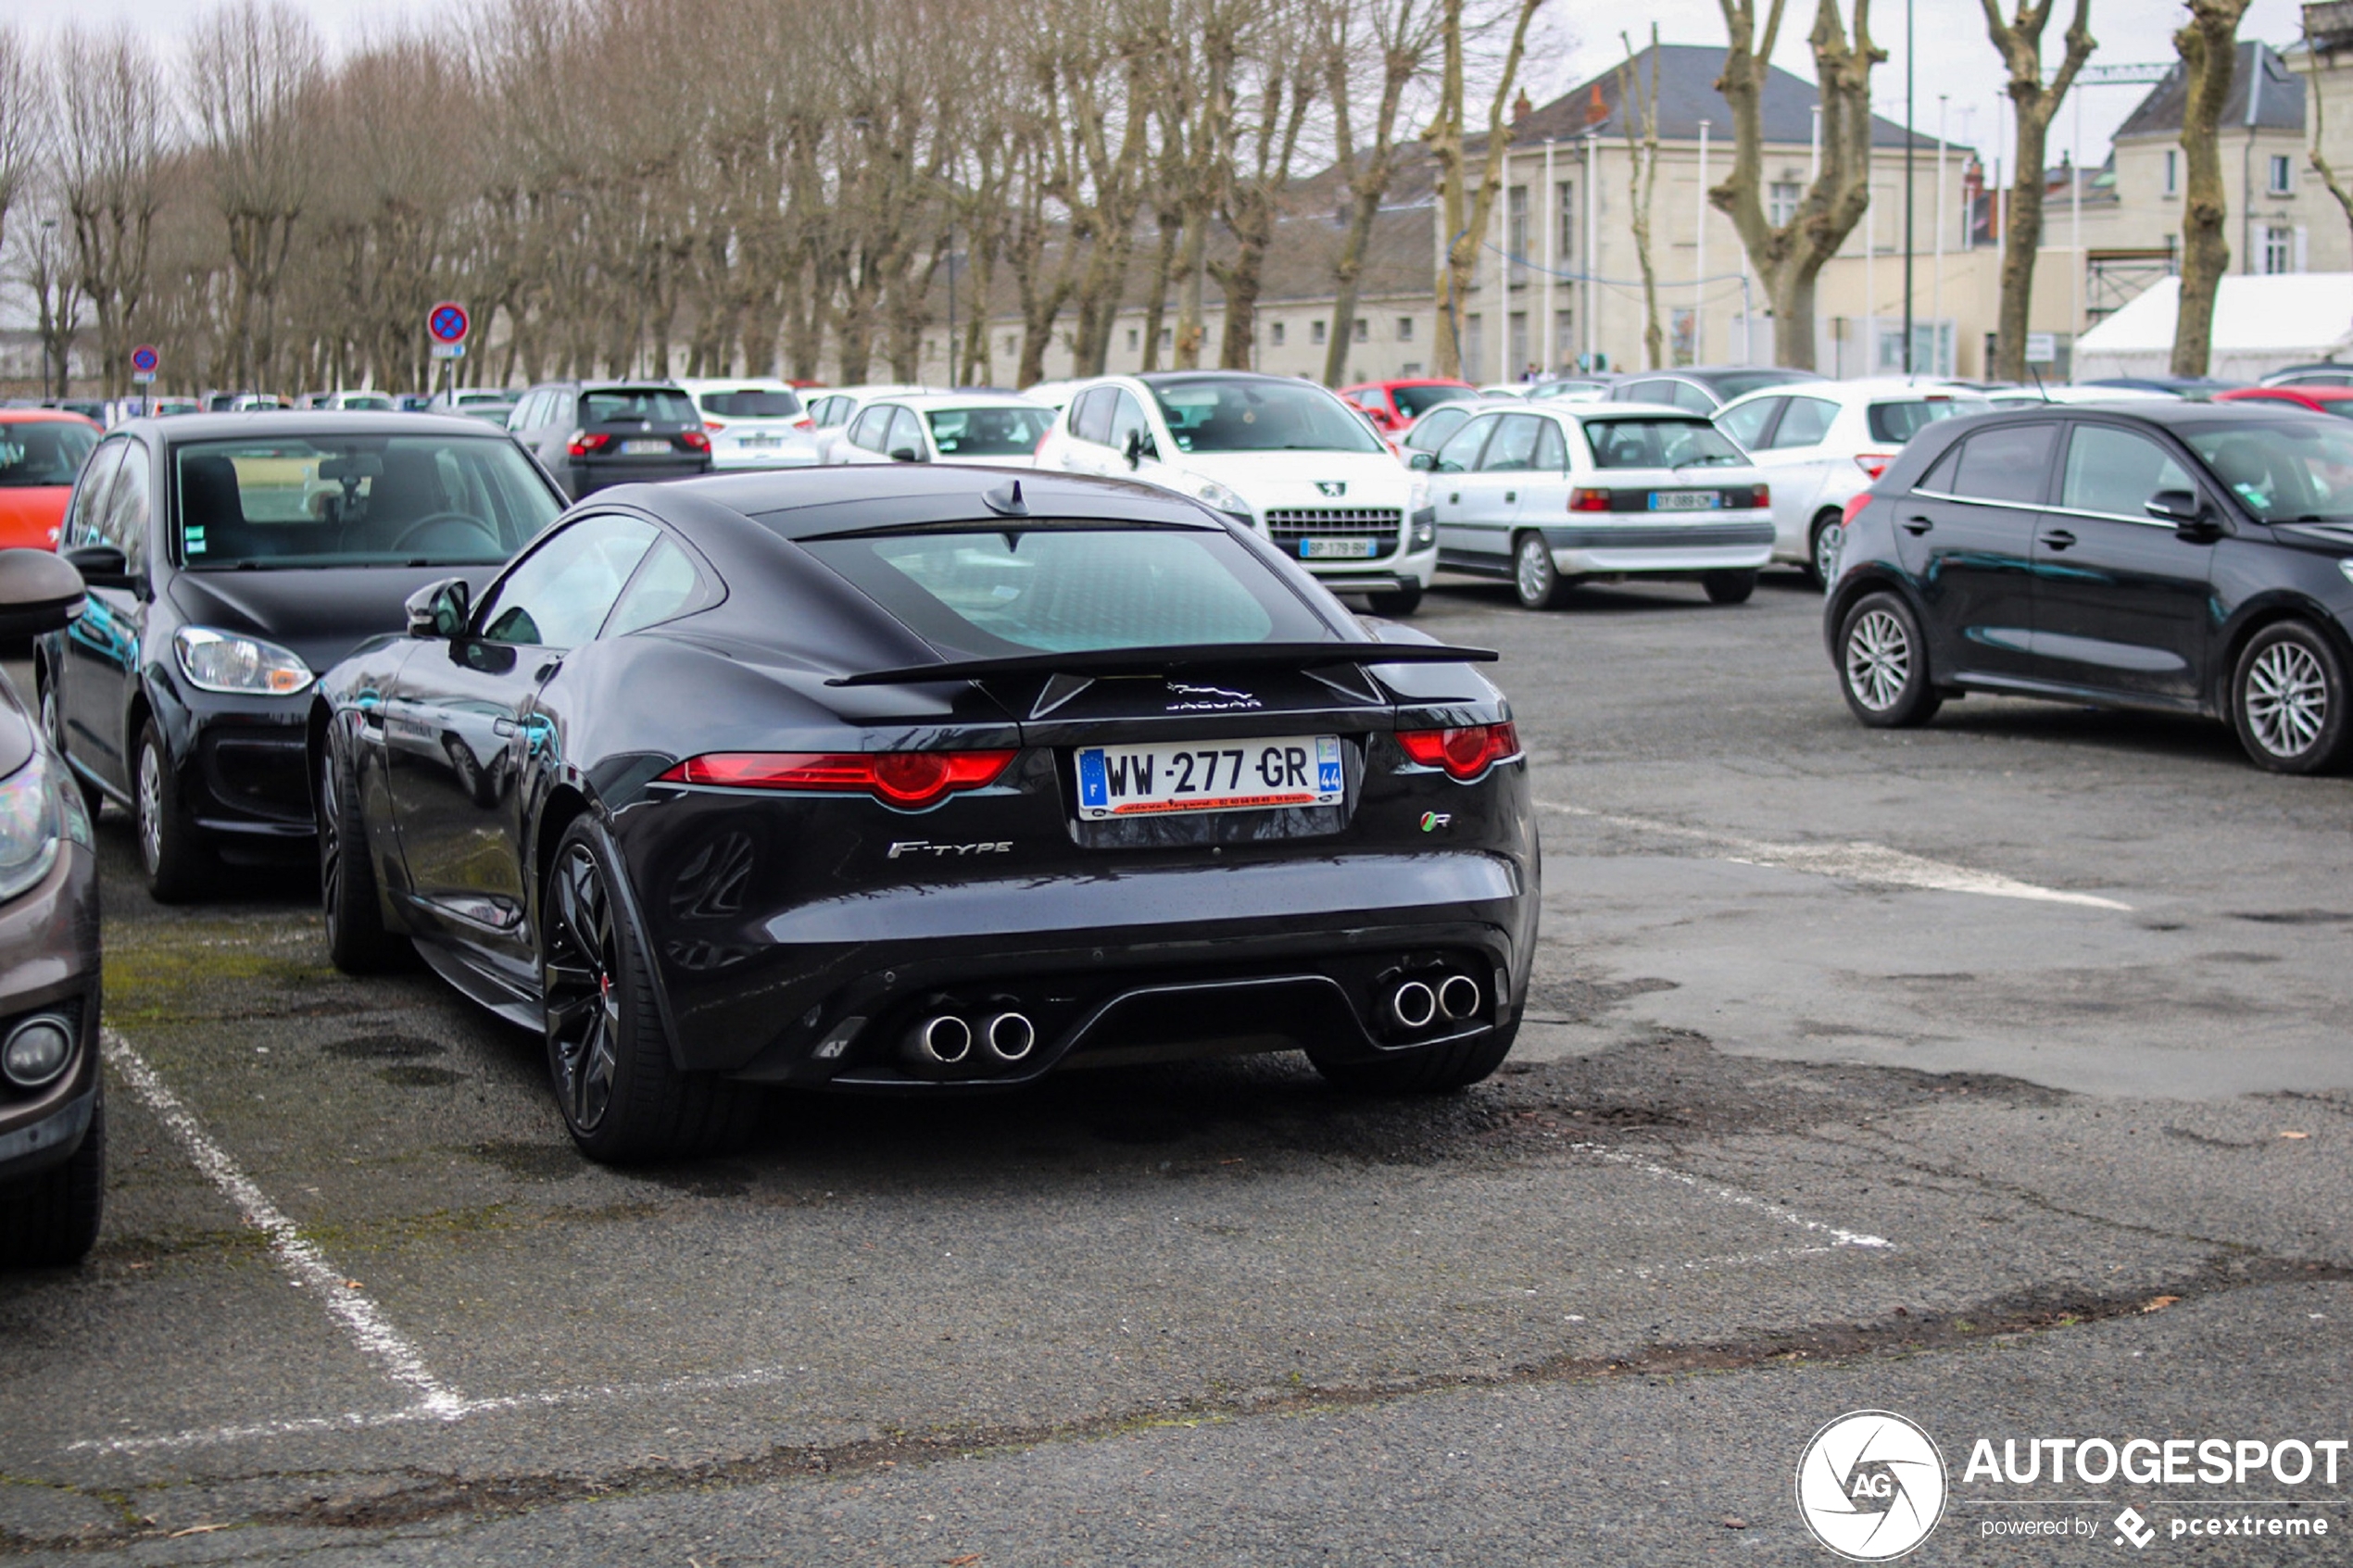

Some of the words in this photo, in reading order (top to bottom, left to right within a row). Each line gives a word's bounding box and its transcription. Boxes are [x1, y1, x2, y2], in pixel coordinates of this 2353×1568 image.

[1166, 698, 1262, 710] JAGUAR
[1321, 768, 1340, 788] 44
[1089, 784, 1098, 797] F
[887, 841, 1013, 859] F-TYPE
